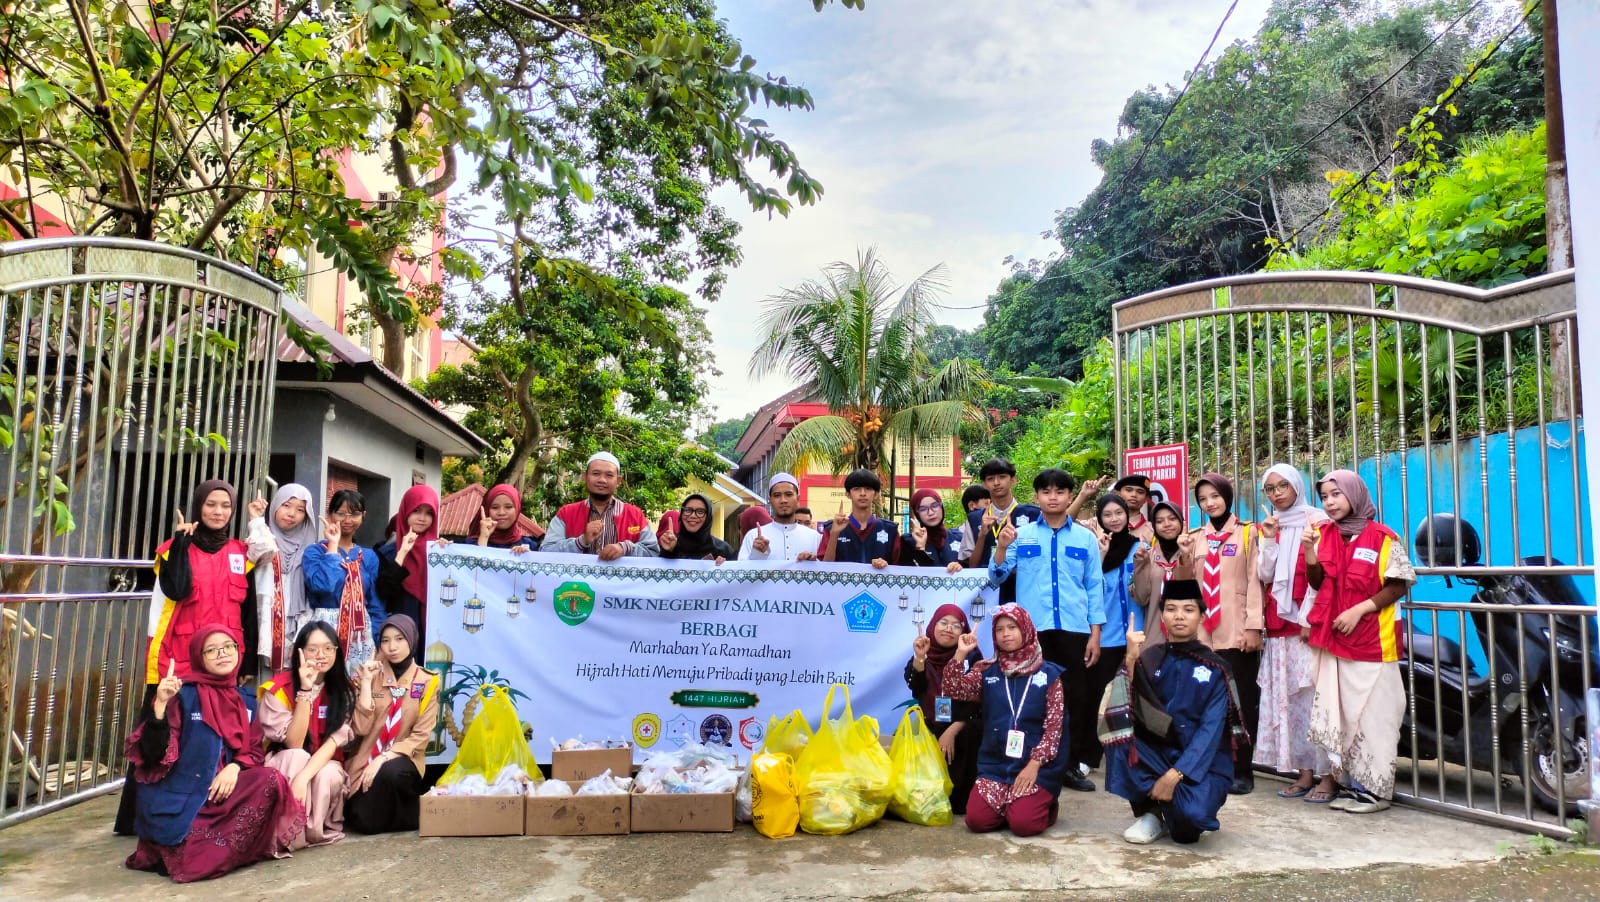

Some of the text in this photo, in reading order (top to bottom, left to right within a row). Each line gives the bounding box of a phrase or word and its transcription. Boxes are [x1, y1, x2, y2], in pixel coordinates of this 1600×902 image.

[1133, 454, 1177, 469] TERIMA KASIH
[1152, 468, 1176, 480] PARKIR
[603, 597, 642, 610] SMK
[646, 598, 711, 611] NEGERI
[714, 598, 730, 611] 17
[731, 598, 836, 616] SAMARINDA
[680, 621, 759, 638] BERBAGI
[629, 640, 792, 659] Marhaban Ya Ramadhan
[576, 662, 856, 687] Hijrah Hati Menuju Pribadi yang Lebih Baik
[684, 694, 746, 704] 1447 HIJRIAH
